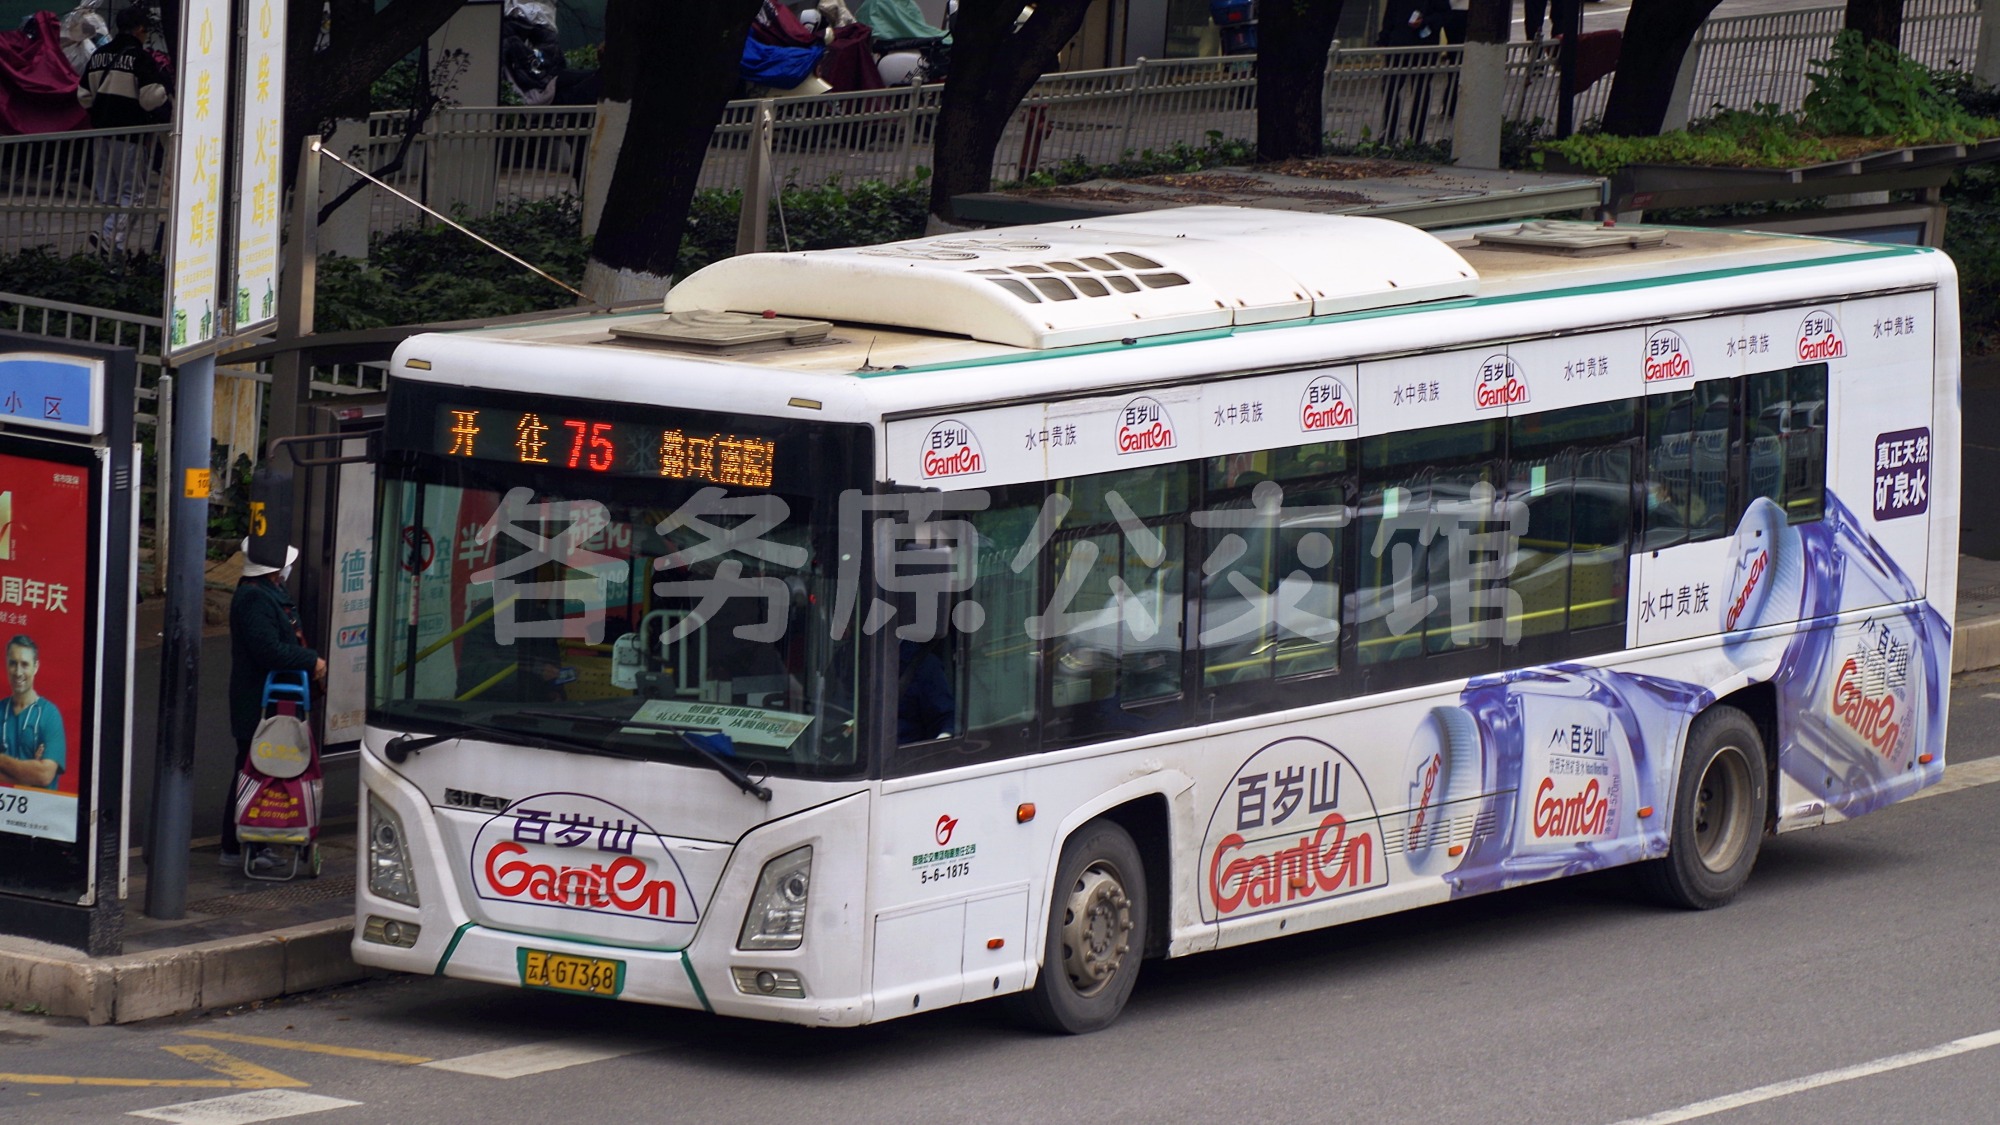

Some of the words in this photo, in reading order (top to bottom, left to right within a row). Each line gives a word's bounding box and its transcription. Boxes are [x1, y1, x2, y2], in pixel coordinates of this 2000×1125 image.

[1804, 318, 1833, 337] 百岁山
[1873, 316, 1915, 339] 水中贵族
[1650, 336, 1680, 356] 百岁山
[1726, 333, 1770, 358] 水中贵族
[1799, 334, 1843, 360] Ganten
[1483, 362, 1515, 382] 百岁山
[1563, 355, 1609, 382] 水中贵族
[1644, 352, 1690, 381] Ganten
[4, 390, 63, 421] 小区
[1309, 384, 1342, 404] 百岁山
[1392, 380, 1440, 406] 水中贵族
[1477, 378, 1526, 408] Ganten
[1125, 405, 1160, 426] 百岁山
[1214, 402, 1264, 427] 水中贵族
[1303, 400, 1353, 429] Ganten
[564, 420, 614, 471] 75
[931, 428, 968, 450] 百岁山
[1025, 424, 1077, 451] 水中贵族
[1119, 421, 1172, 451] Ganten
[924, 446, 980, 476] Ganten
[1876, 436, 1929, 472] 真正天然
[1875, 469, 1927, 512] 矿泉水
[1, 576, 69, 614] 周年庆
[1640, 582, 1710, 623] 水中贵族
[1571, 724, 1606, 756] 百岁山
[1236, 760, 1341, 831] 百岁山
[1533, 776, 1608, 838] Ganten
[513, 808, 638, 855] 百岁山
[921, 862, 970, 884] 5-6-1875
[1209, 812, 1372, 914] Ganten
[485, 841, 676, 918] Ganten
